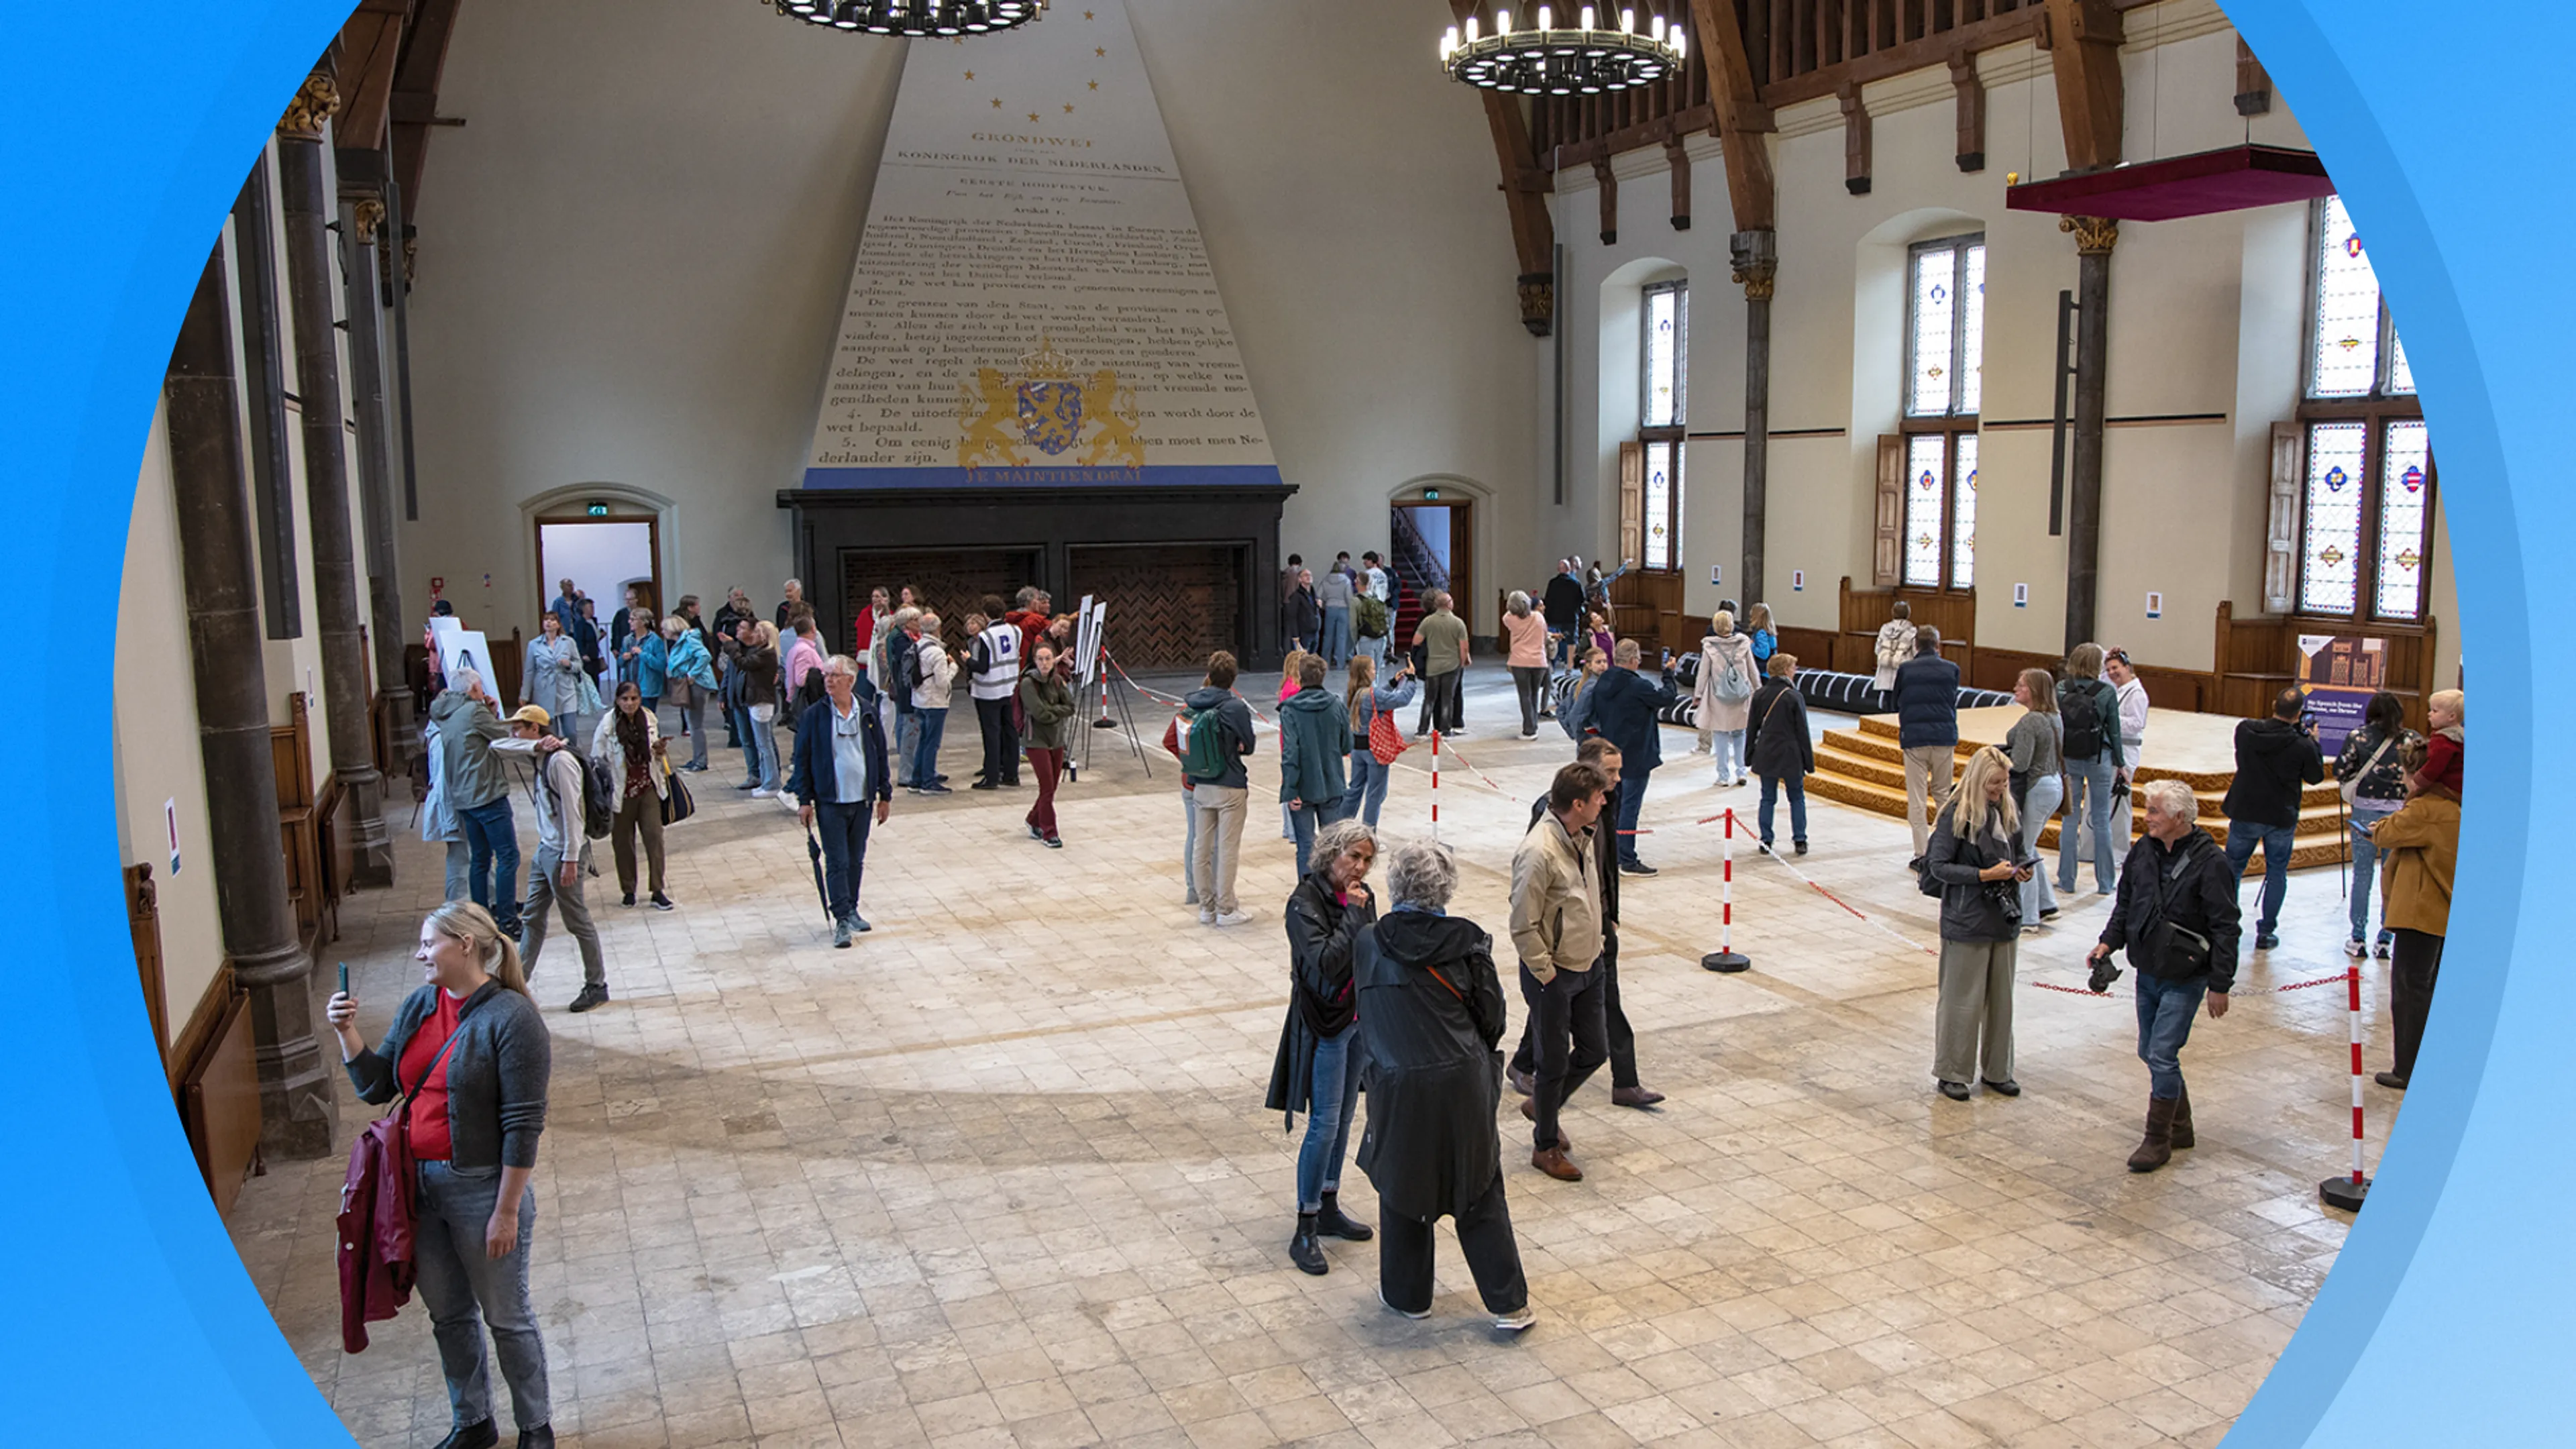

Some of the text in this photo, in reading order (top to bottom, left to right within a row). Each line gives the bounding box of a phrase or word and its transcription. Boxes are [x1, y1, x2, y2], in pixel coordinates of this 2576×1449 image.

[972, 133, 1094, 147] GRONDWET
[898, 150, 1166, 173] KONINGRIJK DER NEDERLANDEN.
[1128, 225, 1165, 234] Europa
[953, 280, 975, 288] kan
[868, 297, 885, 305] De
[898, 300, 947, 308] grenzen
[987, 301, 1009, 309] den
[1095, 303, 1109, 311] de
[849, 309, 904, 317] meenten
[910, 310, 958, 319] kunnen
[966, 311, 994, 319] door
[1002, 312, 1017, 320] de
[1022, 313, 1042, 321] wet
[1051, 313, 1095, 321] worden
[865, 319, 876, 328] 3.
[894, 320, 927, 329] Allen
[934, 321, 953, 329] die
[961, 321, 987, 330] zich
[993, 324, 1008, 332] op
[1015, 323, 1034, 331] het
[1042, 323, 1117, 334] grondgebied
[1155, 325, 1174, 333] het
[1181, 325, 1204, 336] Rijk
[905, 332, 941, 343] hetzij
[946, 333, 1021, 343] ingezetenen
[1026, 334, 1037, 343] of
[1148, 336, 1190, 345] hebben
[1195, 337, 1233, 347] gelijke
[841, 344, 910, 354] aanspraak
[918, 346, 935, 355] op
[943, 344, 1025, 356] bescherming
[1065, 348, 1114, 357] persoon
[857, 355, 875, 364] De
[890, 356, 913, 364] wet
[926, 356, 963, 367] regelt
[973, 356, 989, 366] de
[1080, 358, 1095, 367] de
[1102, 358, 1161, 370] uitzetting
[942, 369, 959, 378] de
[1153, 372, 1169, 382] op
[1177, 370, 1212, 380] welke
[1224, 371, 1243, 380] ten
[834, 381, 888, 390] aanzien
[928, 381, 955, 391] hun
[1134, 382, 1158, 392] met
[1165, 382, 1217, 392] vreemde
[830, 394, 909, 407] gendheden
[917, 394, 971, 404] kunnen
[847, 407, 861, 418] 4.
[881, 407, 901, 418] De
[1164, 407, 1202, 418] wordt
[1206, 407, 1234, 418] door
[1240, 407, 1256, 418] de
[826, 421, 922, 435] wet bepaald.
[842, 437, 856, 448] 5.
[875, 436, 902, 447] Om
[911, 436, 951, 449] eenig
[1169, 434, 1201, 445] moet
[1208, 437, 1236, 445] men
[1240, 434, 1263, 445] Ne-
[818, 451, 937, 466] derlander zijn.
[965, 470, 1141, 483] JE MAINTIENDRAI
